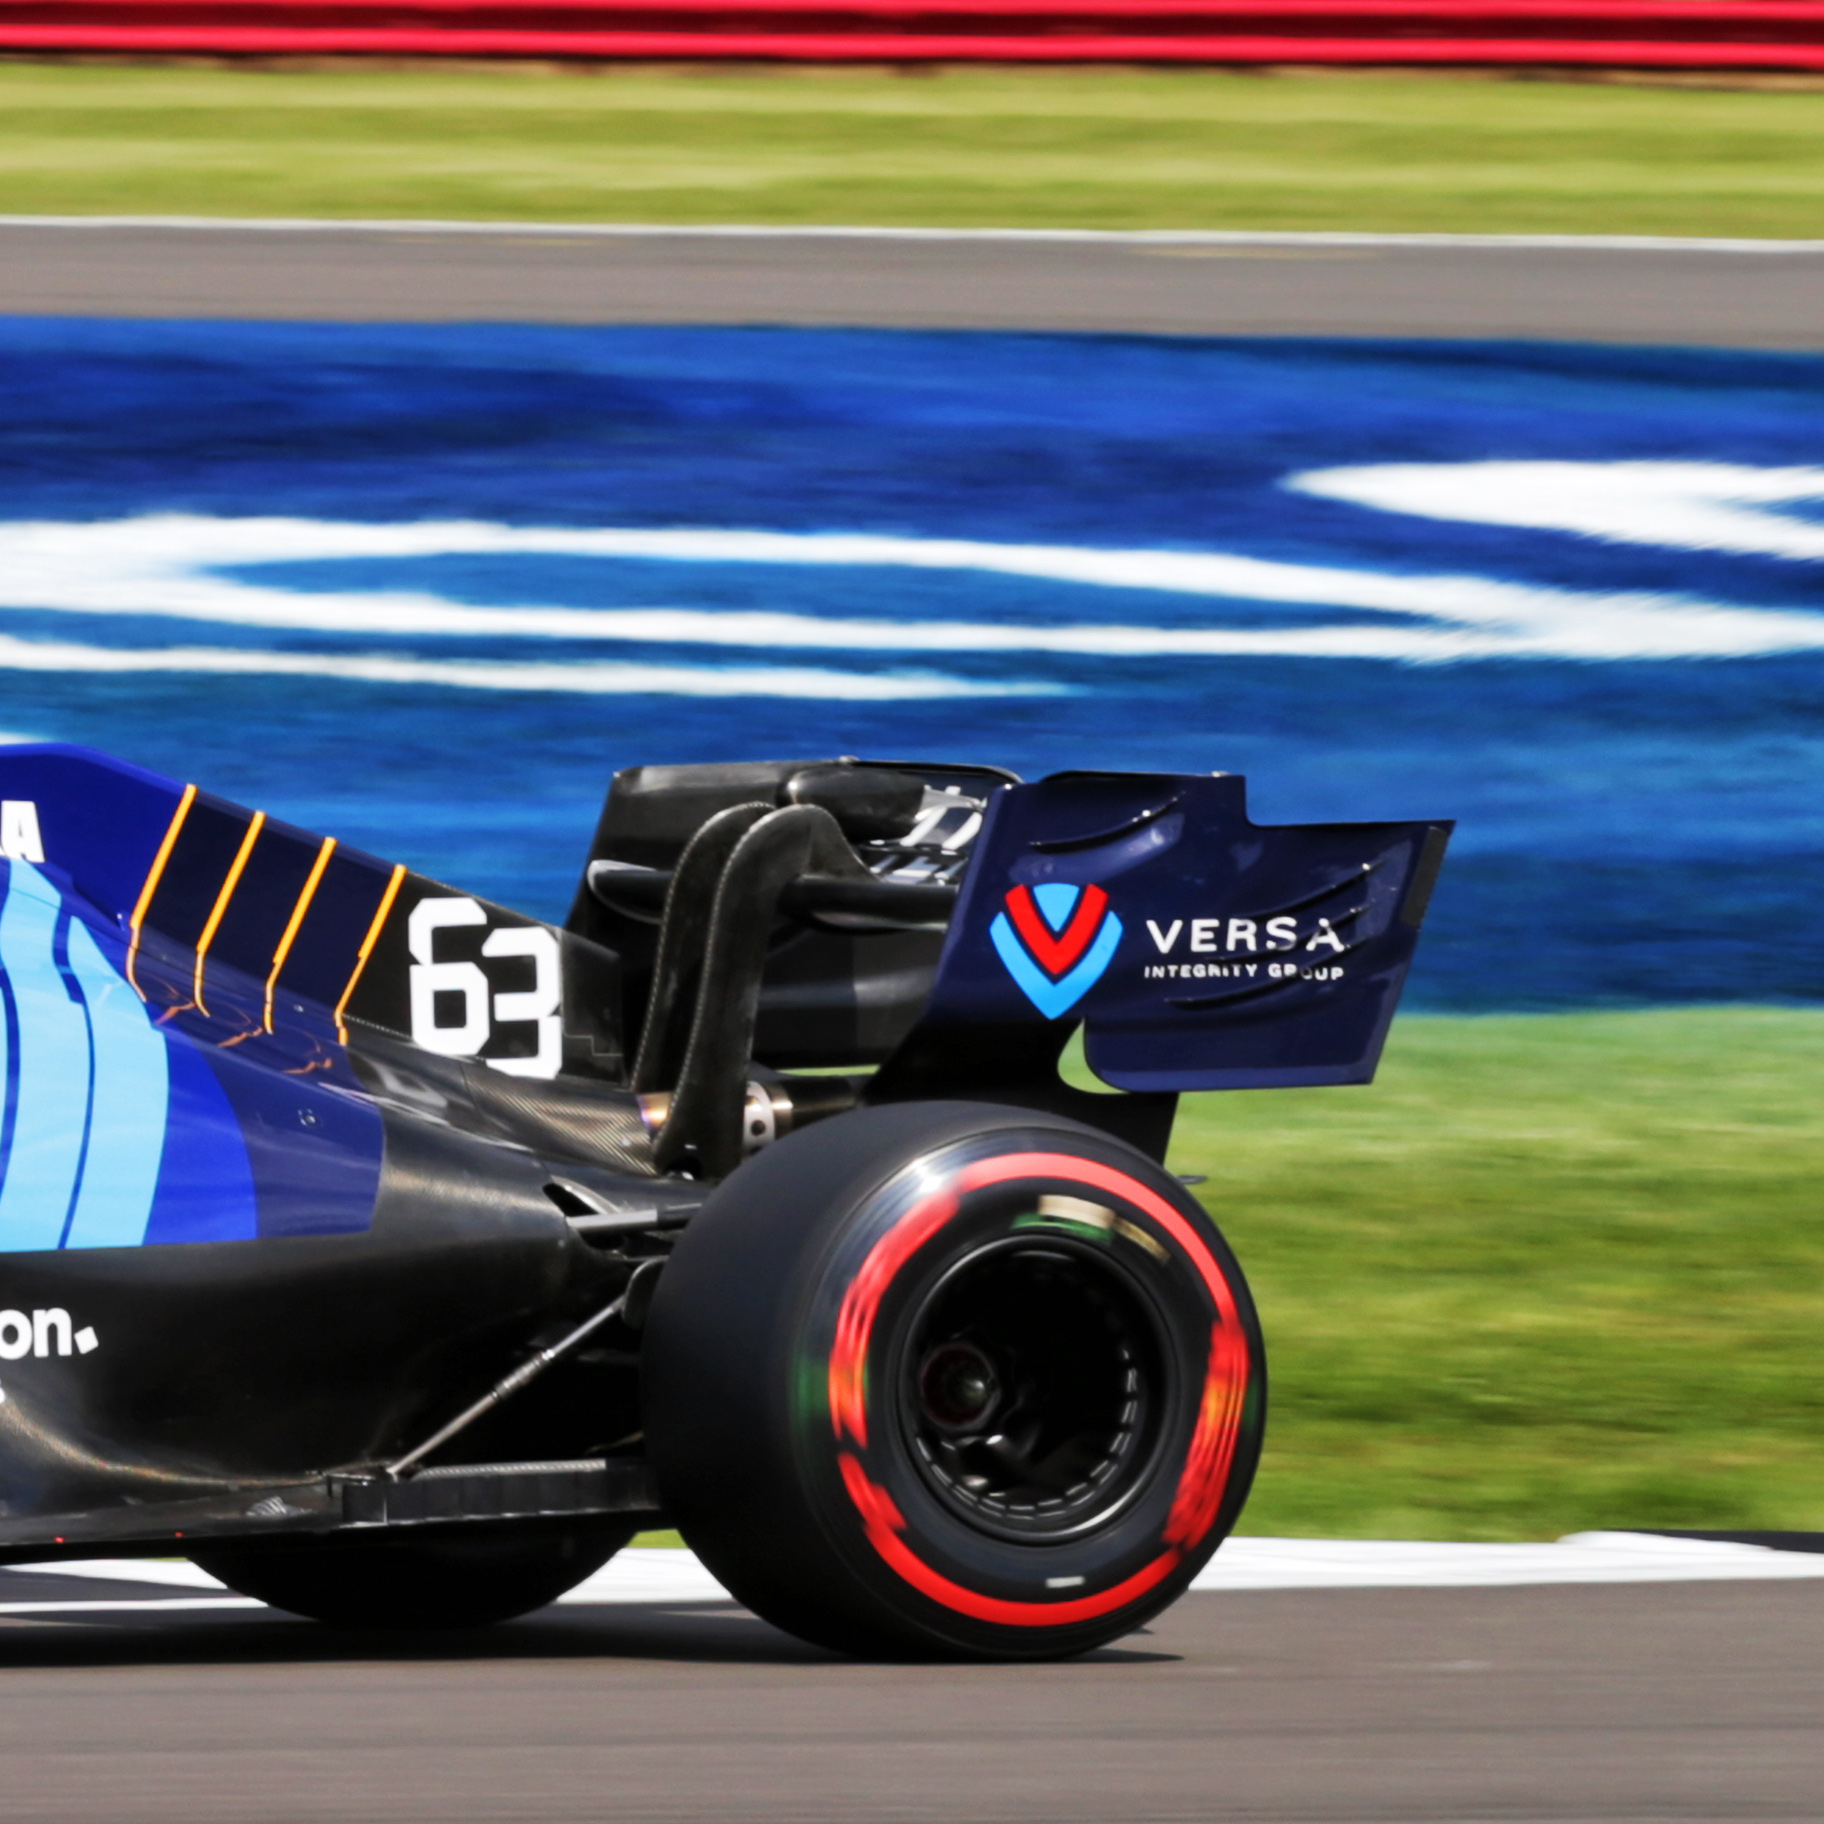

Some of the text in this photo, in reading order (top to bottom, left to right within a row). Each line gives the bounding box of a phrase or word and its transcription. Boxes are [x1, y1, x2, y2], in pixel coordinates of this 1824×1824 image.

[1145, 915, 1346, 955] VERSA
[407, 896, 563, 1081] 63
[1143, 962, 1345, 982] INTEGRITY GROUP
